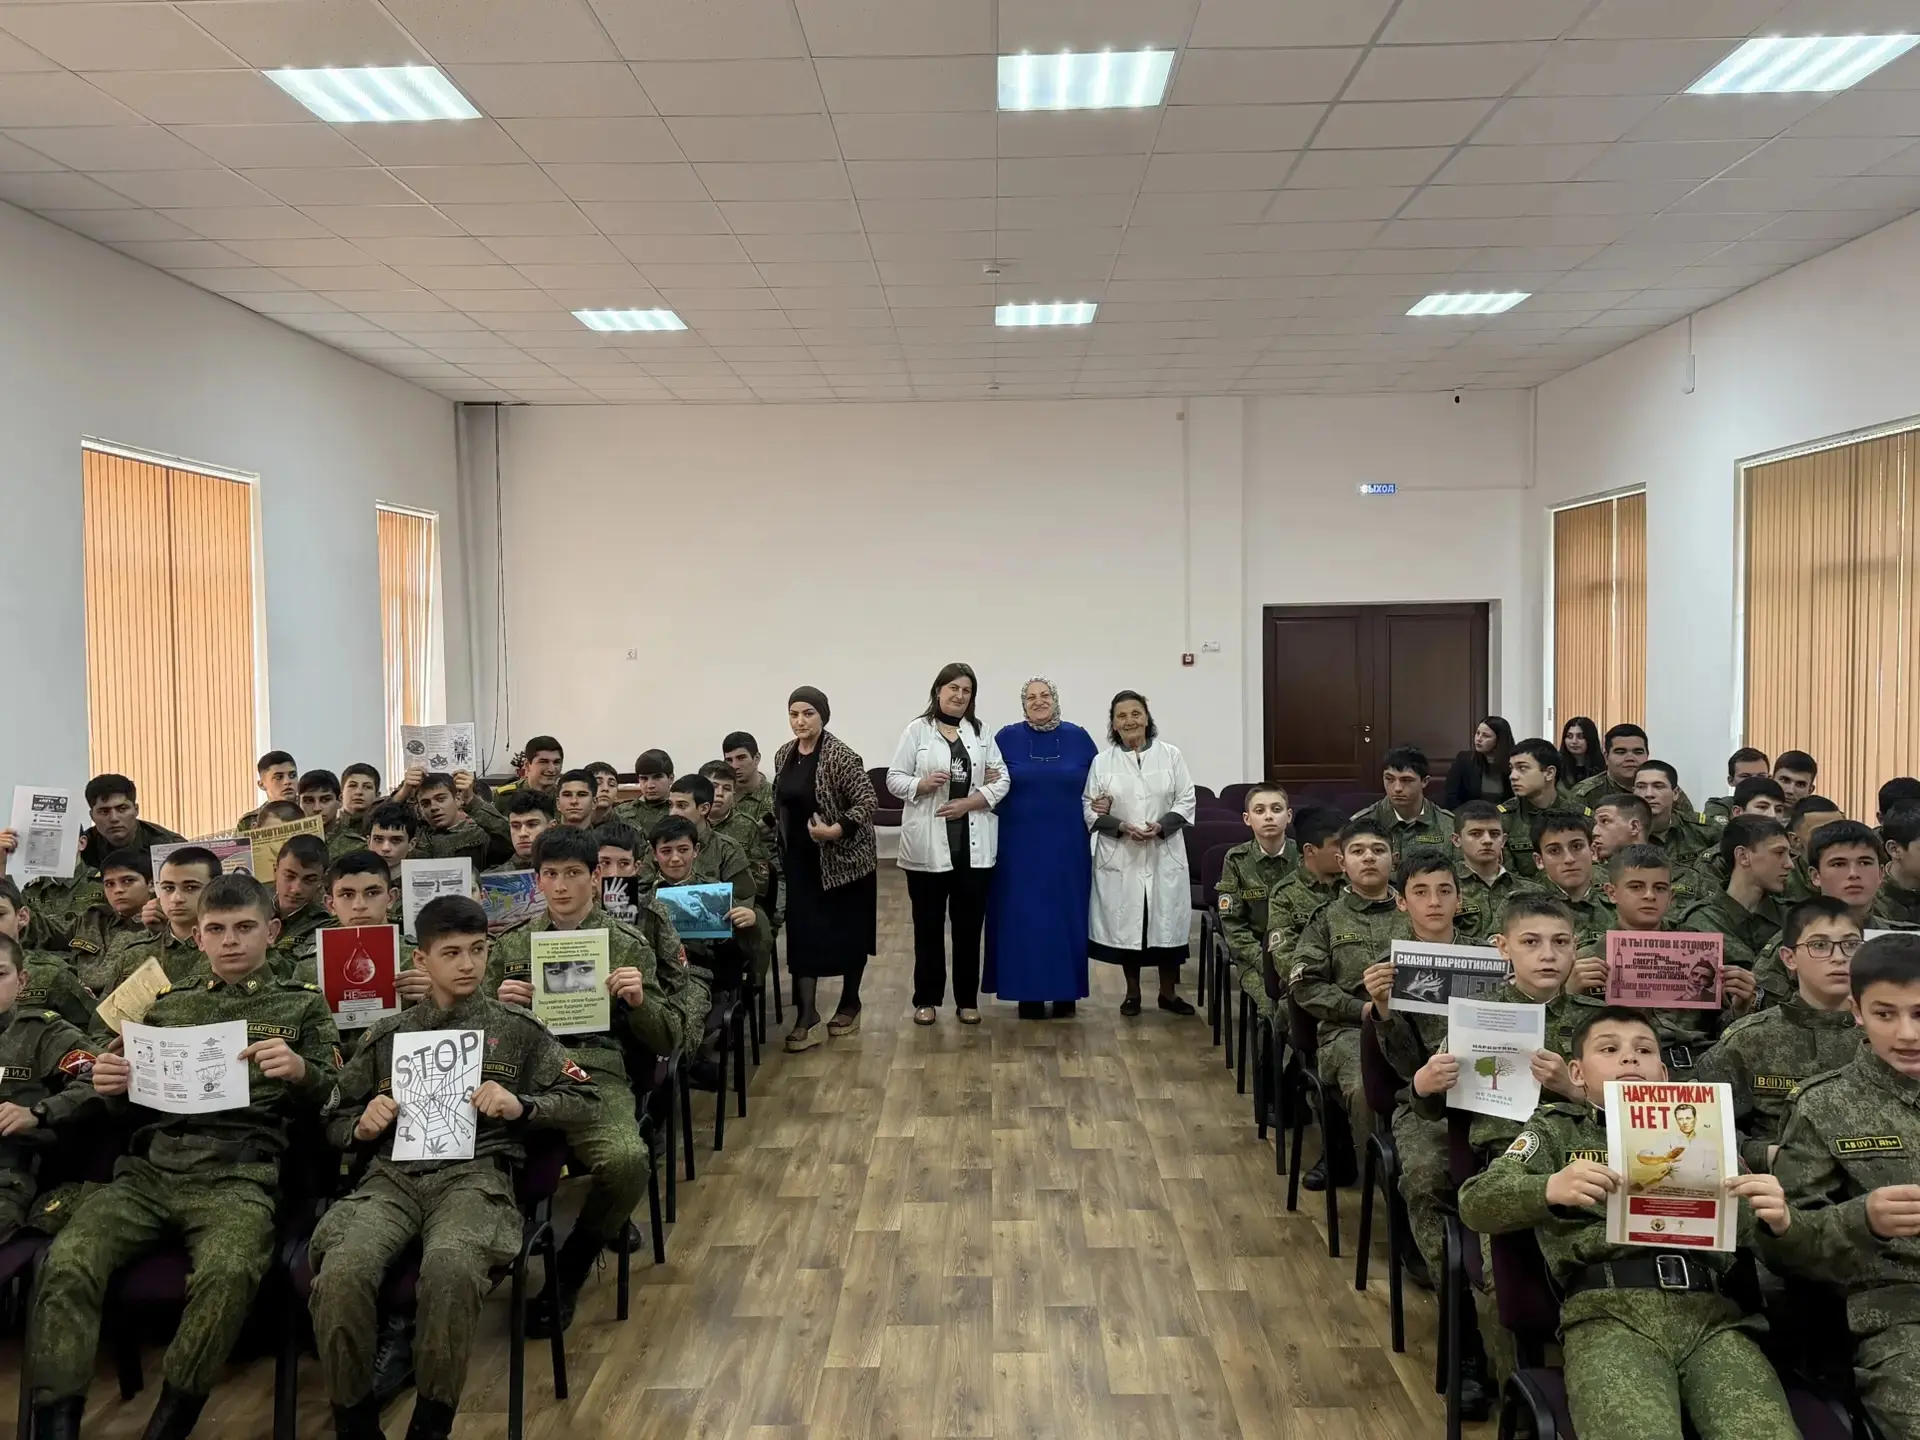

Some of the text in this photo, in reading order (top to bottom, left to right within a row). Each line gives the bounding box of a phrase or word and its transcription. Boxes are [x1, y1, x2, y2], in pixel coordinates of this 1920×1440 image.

[1628, 938, 1644, 948] ТЫ
[1645, 938, 1671, 949] ГОТОВ
[1673, 940, 1680, 949] К
[1396, 953, 1506, 972] СКАЖИ НАРКОТИКАМ!
[395, 1031, 479, 1089] STOP
[1785, 1078, 1798, 1088] Rh
[1622, 1085, 1715, 1104] НАРКОТИКАМ
[1629, 1105, 1671, 1130] НЕТ
[1844, 1138, 1898, 1150] AB(IV) Rh+
